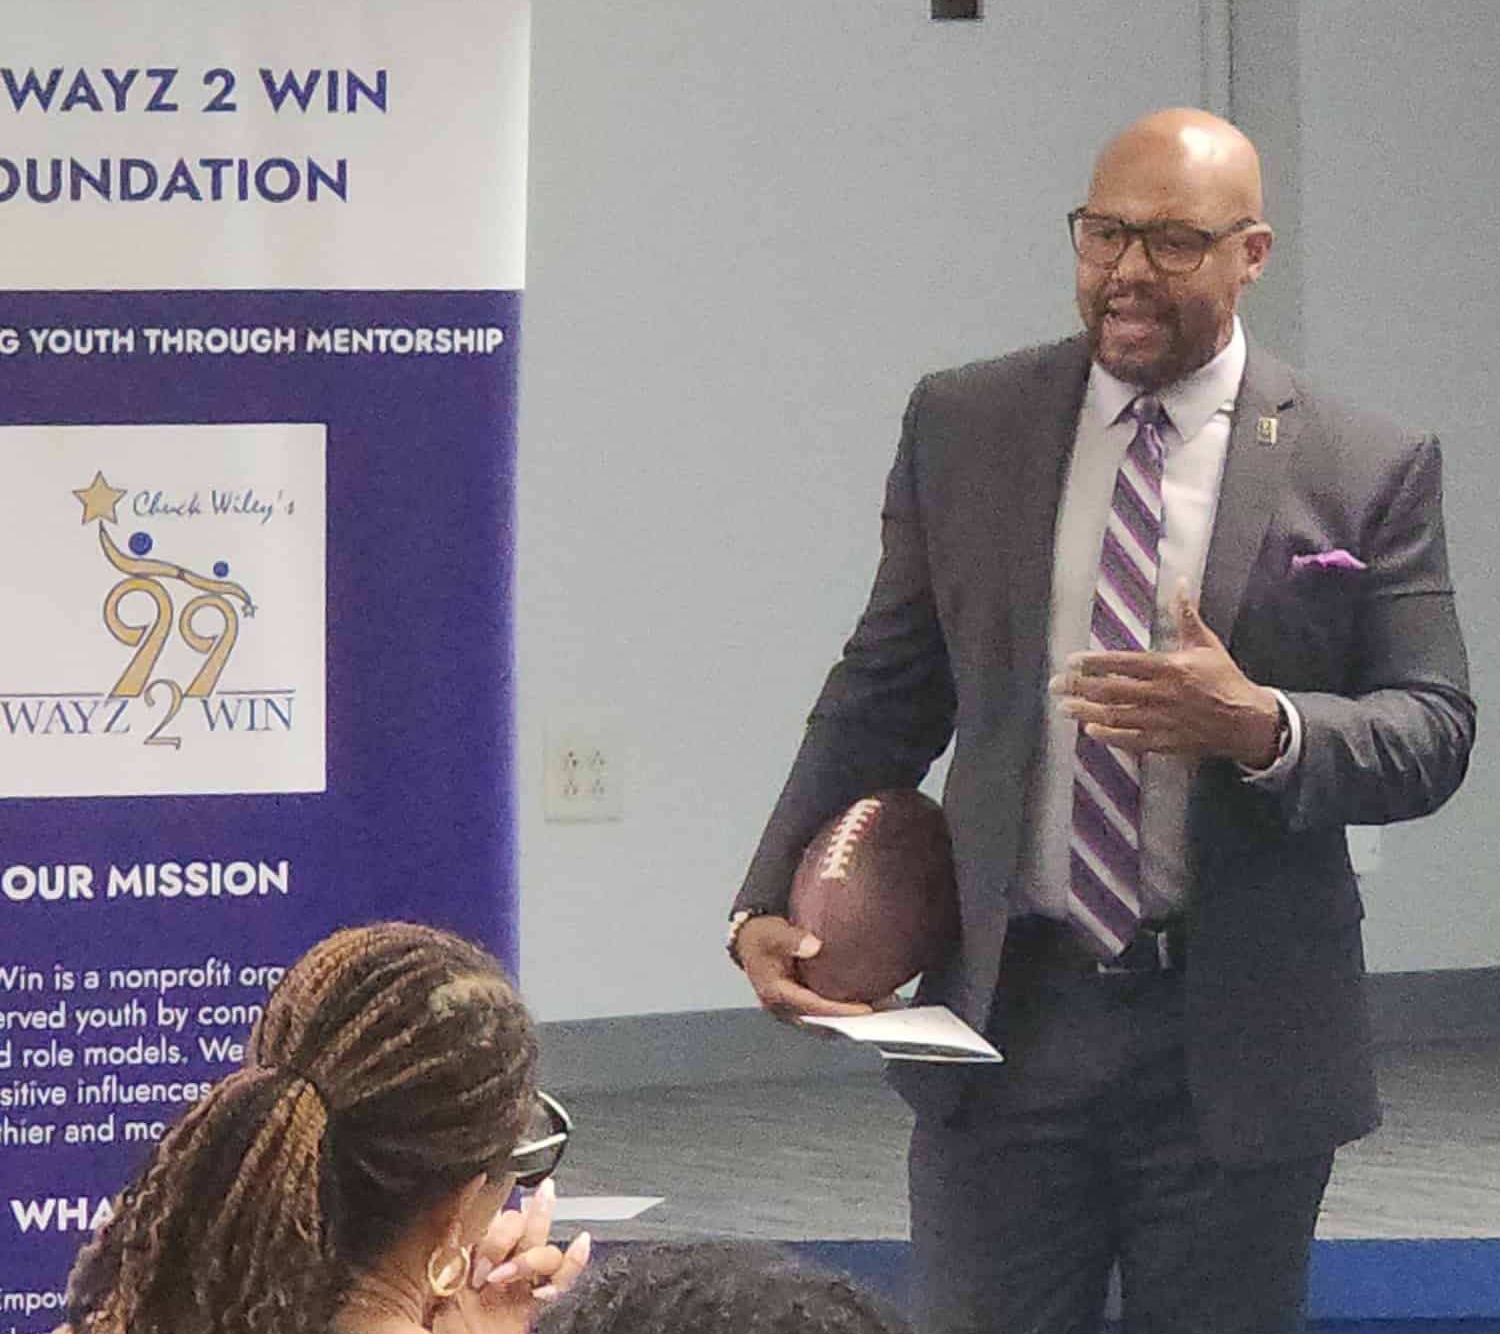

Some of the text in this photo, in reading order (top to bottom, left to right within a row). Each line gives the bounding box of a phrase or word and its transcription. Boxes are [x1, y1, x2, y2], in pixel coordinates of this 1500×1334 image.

[1, 67, 388, 113] WAYZ 2 WIN
[29, 328, 134, 355] YOUTH
[143, 328, 295, 354] THROUGH
[305, 328, 504, 354] MENTORSHIP
[132, 489, 296, 525] Chuck Wiley's
[104, 575, 238, 699] 99
[1, 679, 295, 750] WAYZ 2 WIN
[2, 860, 290, 901] OUR MISSION
[54, 963, 75, 991] is
[84, 970, 99, 990] a
[109, 957, 231, 994] nonprofit
[76, 998, 147, 1035] youth
[158, 998, 189, 1032] by
[23, 1038, 74, 1067] role
[84, 1035, 189, 1066] models.
[199, 1035, 244, 1063] We
[0, 1114, 55, 1146] hier
[64, 1113, 115, 1143] and
